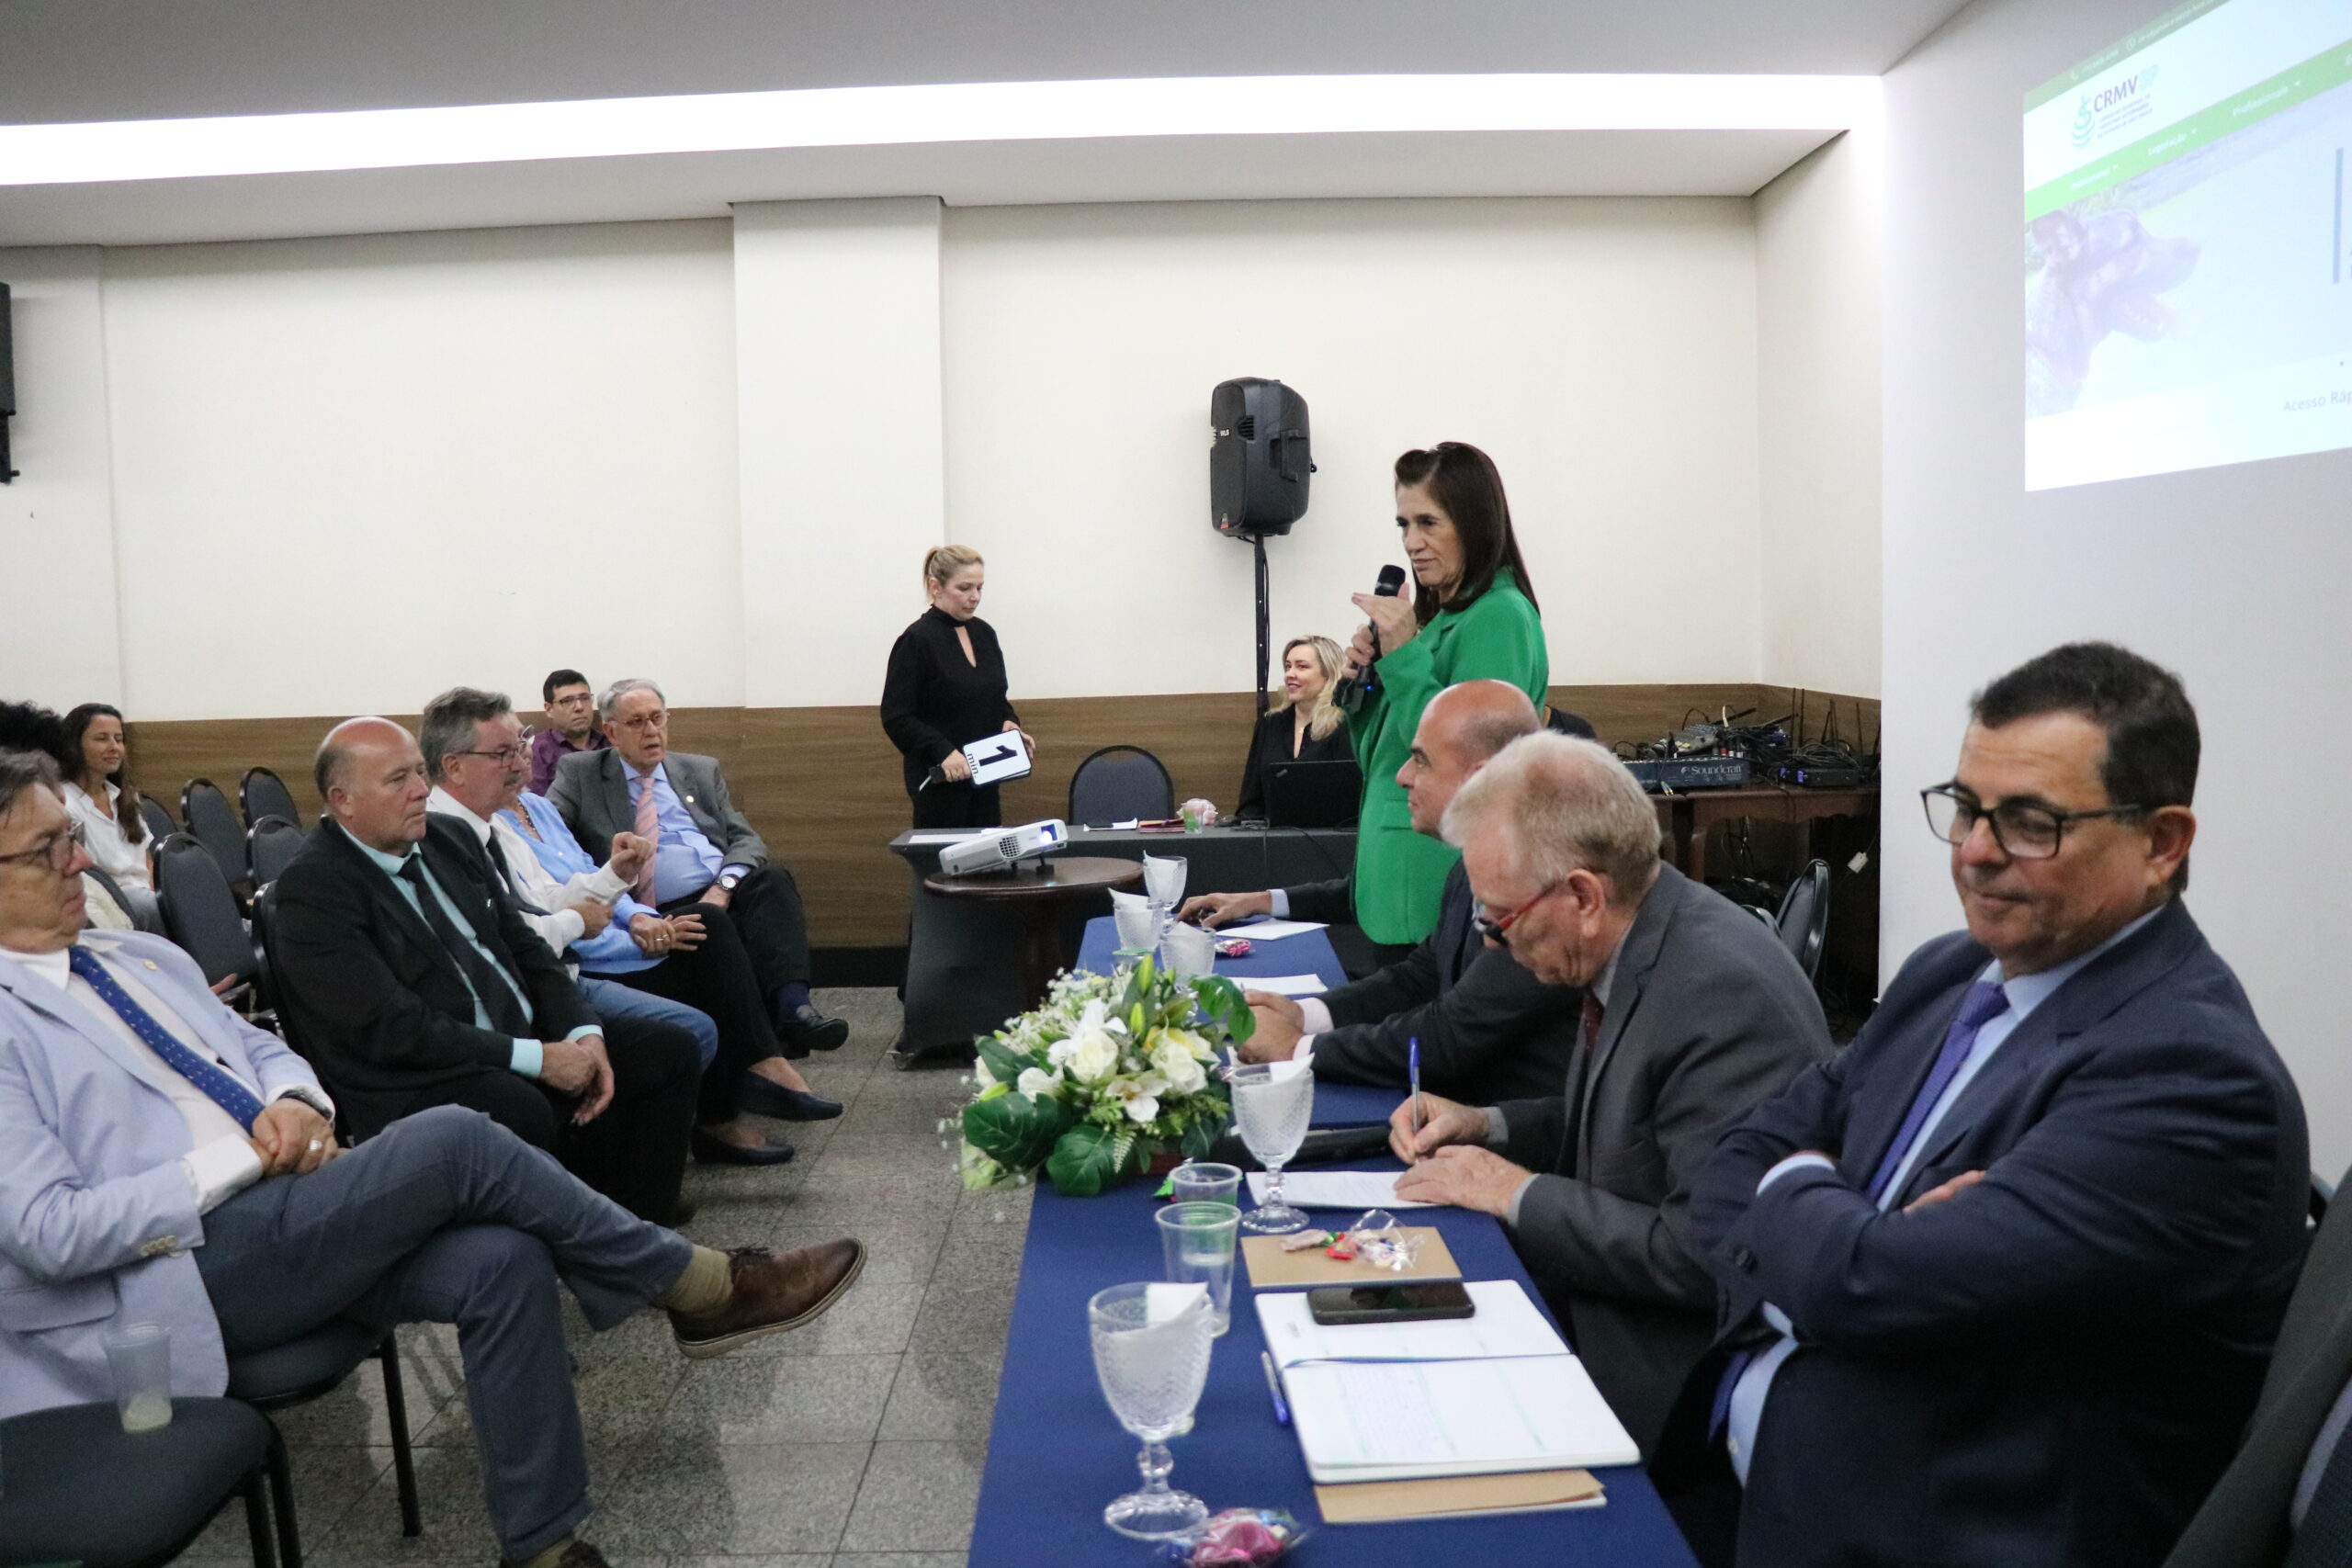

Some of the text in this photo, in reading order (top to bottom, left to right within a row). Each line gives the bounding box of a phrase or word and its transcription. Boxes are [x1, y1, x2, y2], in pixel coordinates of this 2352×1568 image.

[2094, 74, 2138, 113] CRMV
[2282, 397, 2326, 412] Acesso
[978, 745, 1018, 767] 1
[1690, 764, 1742, 774] Soundcraft
